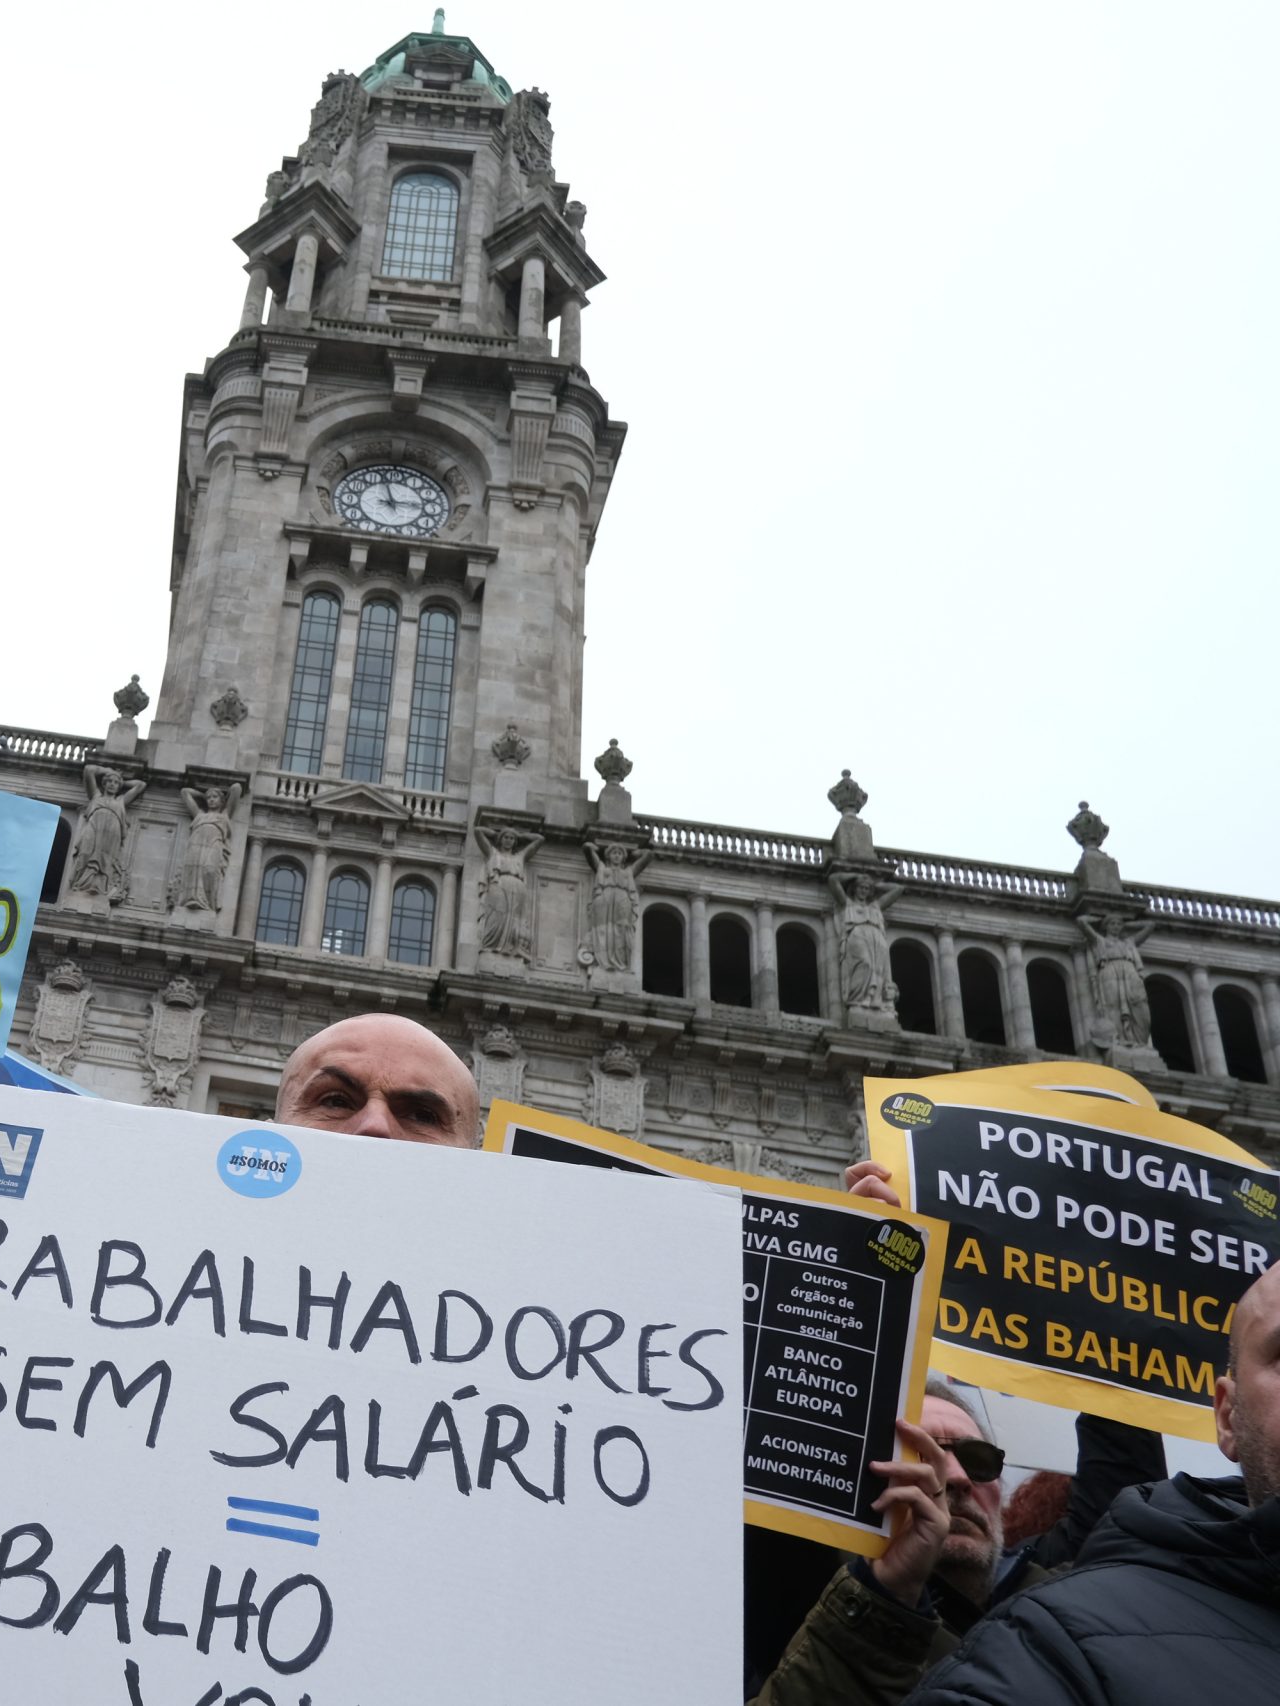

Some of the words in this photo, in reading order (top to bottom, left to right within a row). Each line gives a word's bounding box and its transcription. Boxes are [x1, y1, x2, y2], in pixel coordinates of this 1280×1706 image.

[228, 1154, 288, 1173] #SOMOS
[978, 1121, 1223, 1204] PORTUGAL
[937, 1169, 1041, 1220] NÃO
[1056, 1195, 1176, 1256] PODE
[1190, 1228, 1269, 1275] SER
[787, 1239, 839, 1263] GMG
[867, 1240, 884, 1254] DAS
[953, 1237, 989, 1275] A
[802, 1271, 848, 1290] Outros
[790, 1286, 836, 1305] órgãos
[838, 1296, 855, 1310] de
[776, 1303, 863, 1330] comunicação
[938, 1297, 1029, 1350] DAS
[800, 1325, 838, 1342] social
[783, 1346, 843, 1371] BANCO
[764, 1364, 858, 1398] ATLÂNTICO
[776, 1389, 843, 1417] EUROPA
[761, 1434, 848, 1466] ACIONISTAS
[747, 1455, 854, 1493] MINORITÁRIOS
